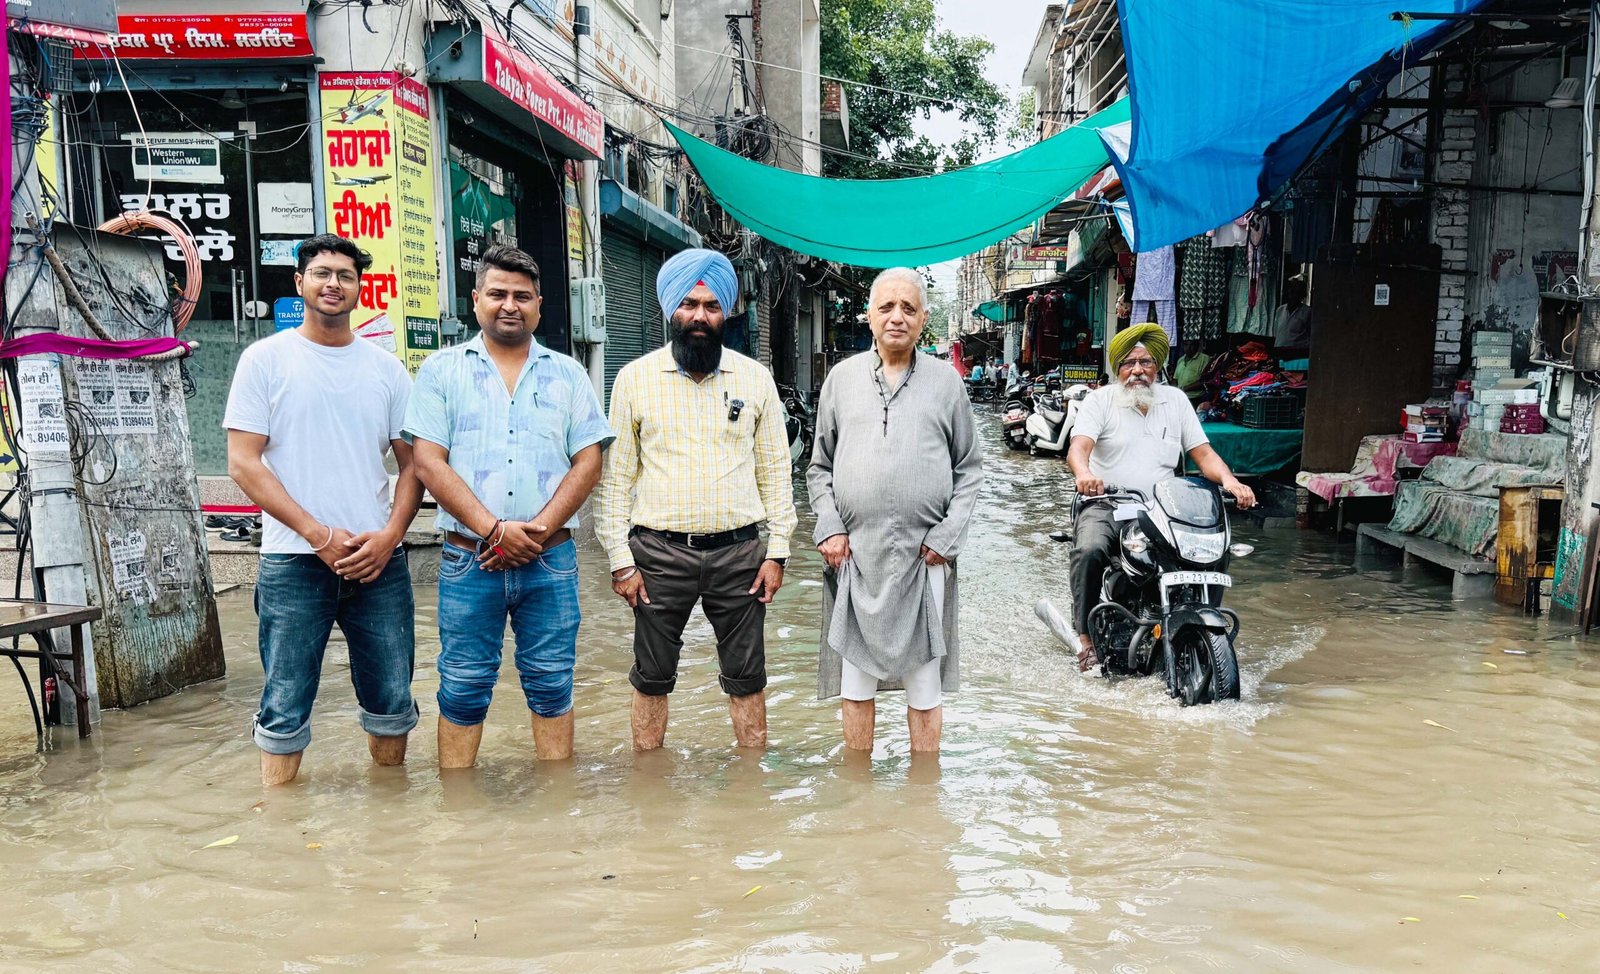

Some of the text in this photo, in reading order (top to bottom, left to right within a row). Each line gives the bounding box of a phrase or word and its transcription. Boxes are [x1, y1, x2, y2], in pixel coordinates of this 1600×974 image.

[494, 58, 525, 102] Takyar
[525, 81, 547, 115] Forex
[547, 97, 562, 127] Pvt.
[563, 108, 576, 136] Ltd.
[136, 137, 167, 145] RECEIVE
[151, 149, 185, 157] Western
[162, 156, 185, 164] Union
[271, 206, 314, 215] MoneyGram
[333, 189, 393, 239] ਦੀਆਂ
[1064, 370, 1098, 379] SUBHASH
